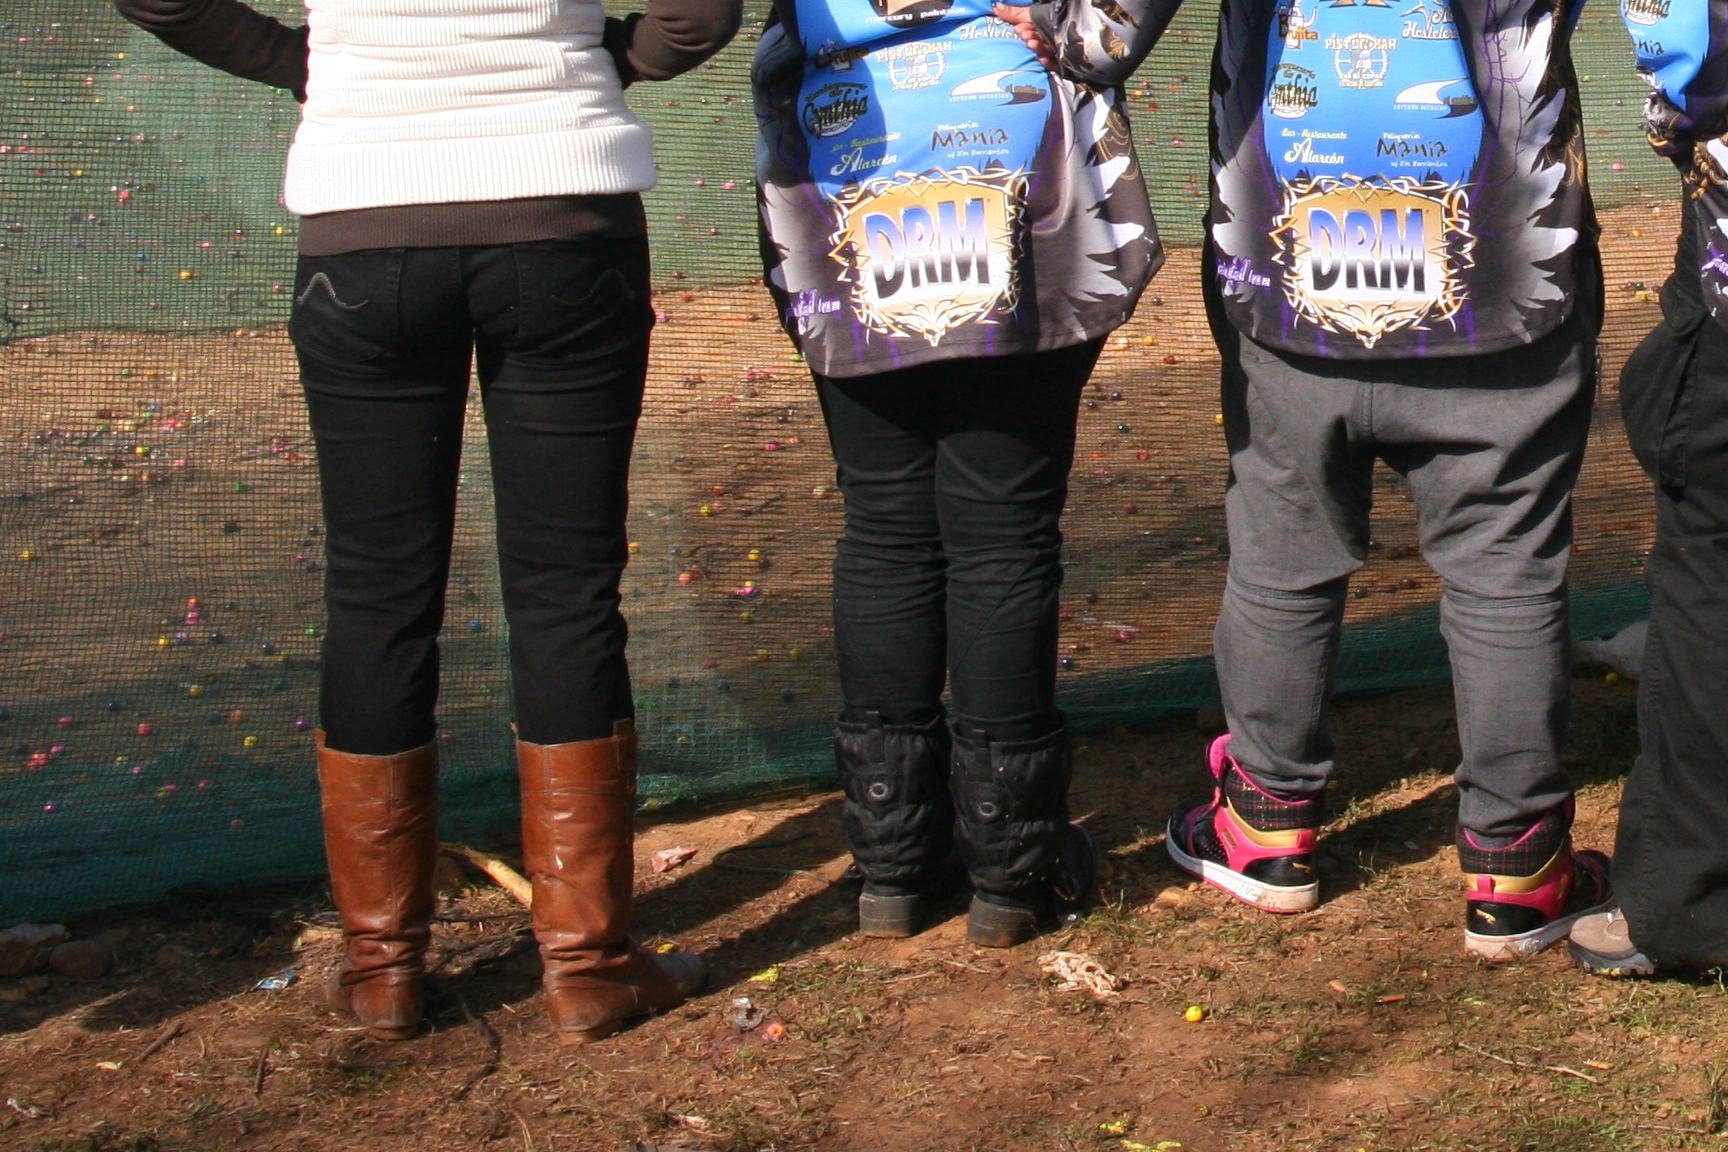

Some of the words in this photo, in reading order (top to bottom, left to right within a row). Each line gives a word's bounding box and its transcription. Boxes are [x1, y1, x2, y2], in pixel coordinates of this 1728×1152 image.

[931, 128, 1010, 151] Mania
[1284, 138, 1345, 164] Alarcón
[1376, 138, 1448, 158] Mania
[862, 197, 992, 300] DRM
[1308, 207, 1426, 295] DRM
